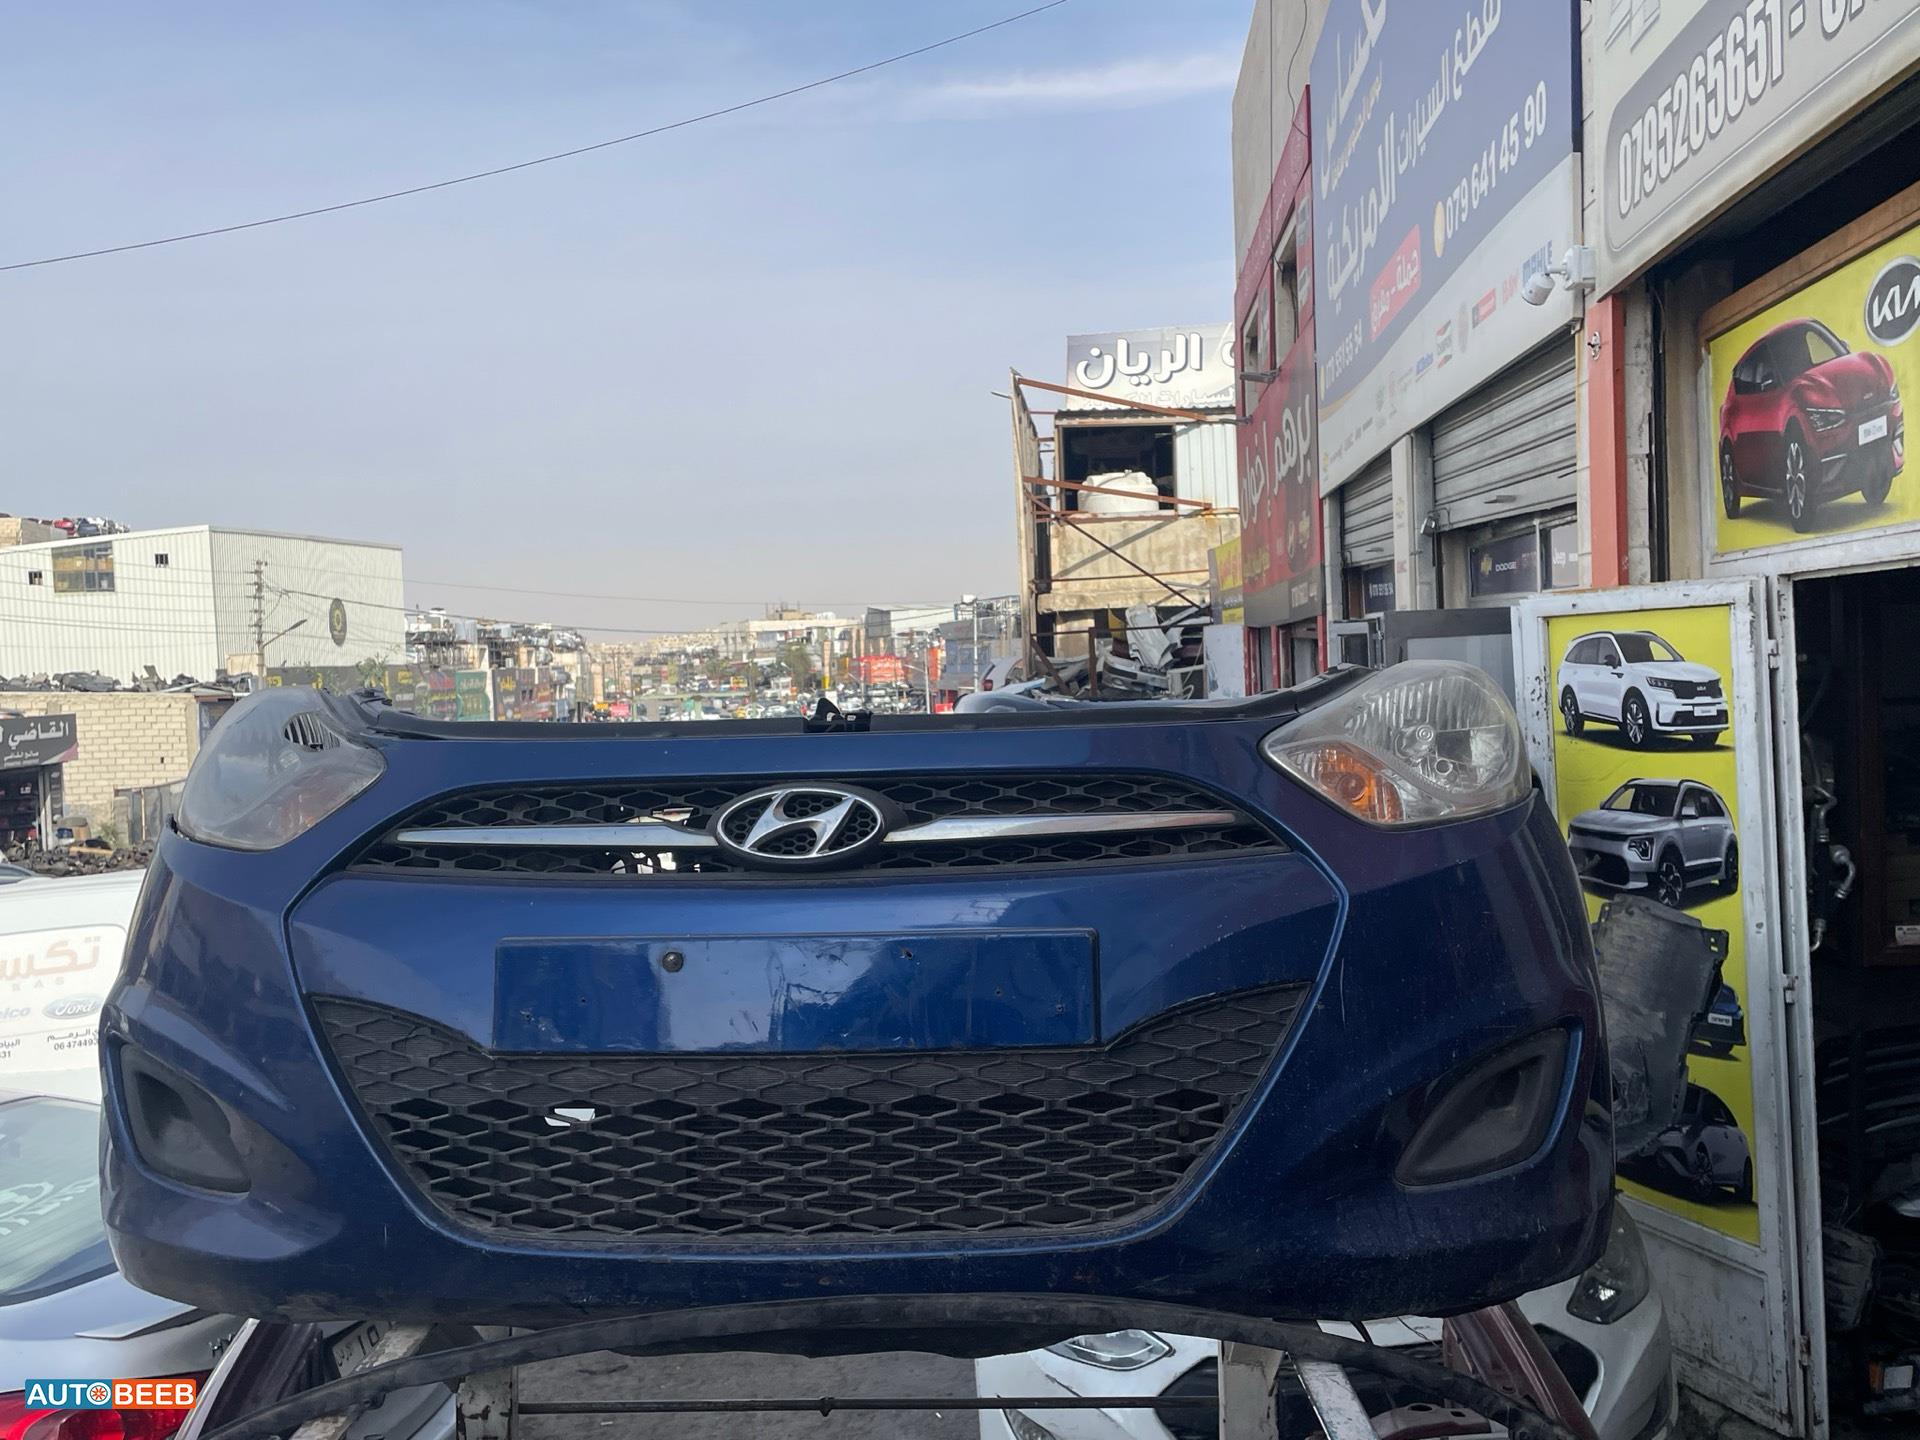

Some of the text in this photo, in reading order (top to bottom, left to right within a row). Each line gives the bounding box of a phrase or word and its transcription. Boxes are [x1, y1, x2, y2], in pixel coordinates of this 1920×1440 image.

[1397, 48, 1449, 174] السيارات
[1617, 0, 1783, 217] 0795265651
[1446, 80, 1547, 239] 079 641 45 90
[1076, 333, 1202, 388] الريان
[1495, 561, 1517, 572] DODGE
[8, 721, 69, 750] القاضي
[55, 1001, 97, 1016] Ford
[54, 1043, 65, 1051] 06
